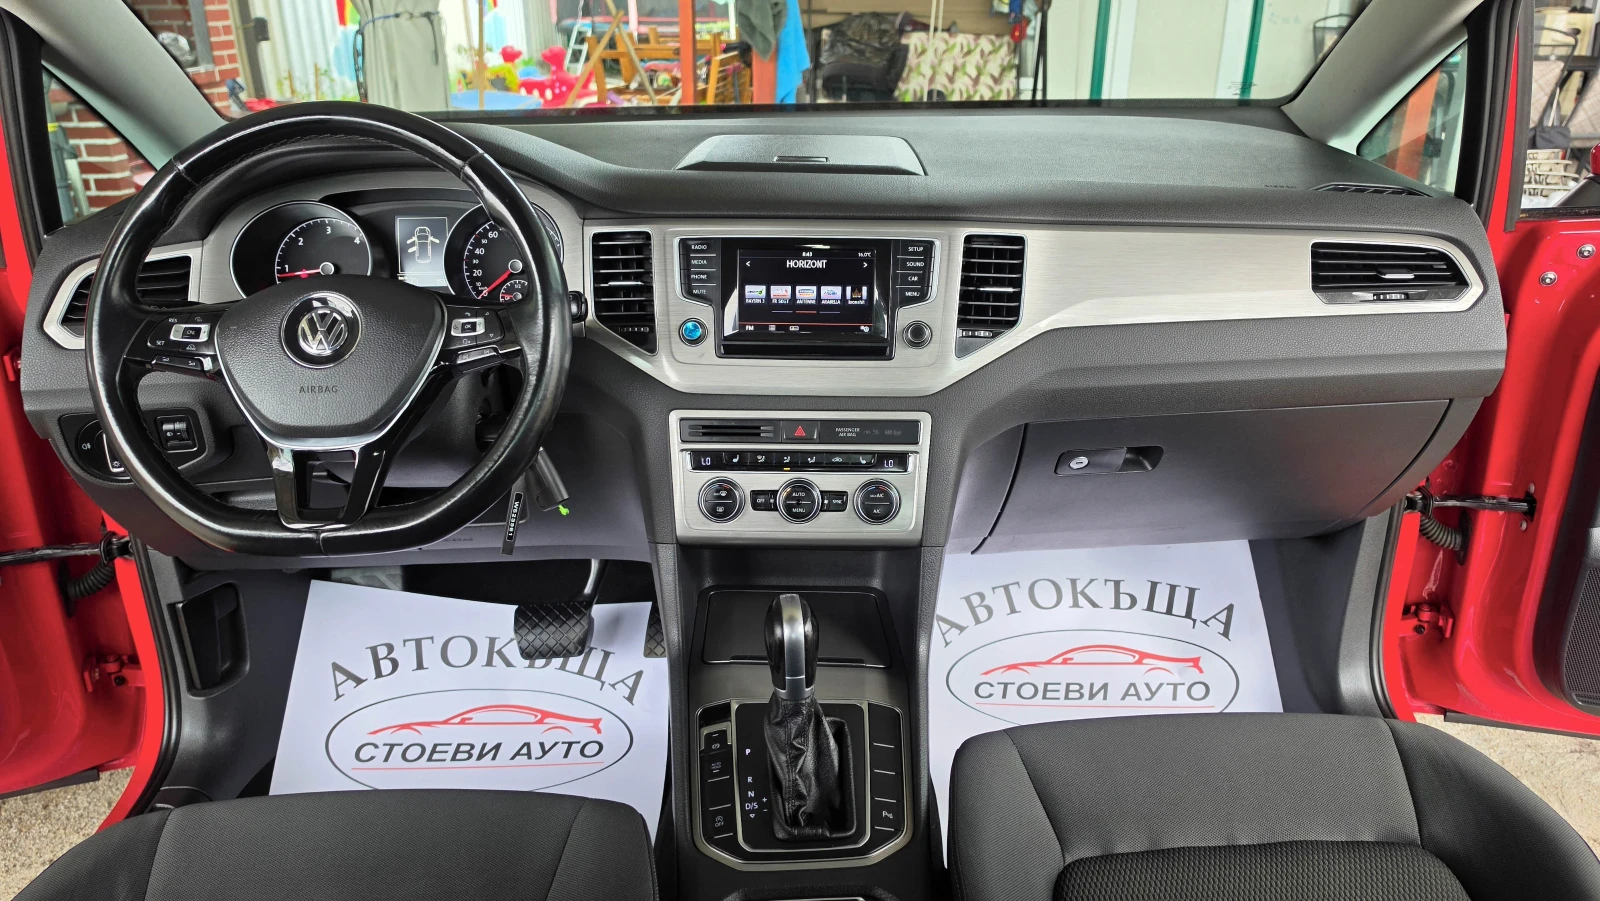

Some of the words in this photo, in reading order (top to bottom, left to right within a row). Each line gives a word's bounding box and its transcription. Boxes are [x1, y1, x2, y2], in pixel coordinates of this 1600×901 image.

[326, 226, 331, 234] 3
[786, 260, 827, 268] HORIZONT
[299, 385, 338, 394] AIRBAG
[885, 460, 893, 468] LO
[936, 578, 1235, 648] АВТОКЪЩА
[330, 635, 644, 706] АВТОКЩА
[974, 682, 1108, 701] СТОЕВИ
[1120, 681, 1210, 701] АУТО
[354, 742, 502, 762] СТОЕВИ
[510, 740, 604, 760] АУТО
